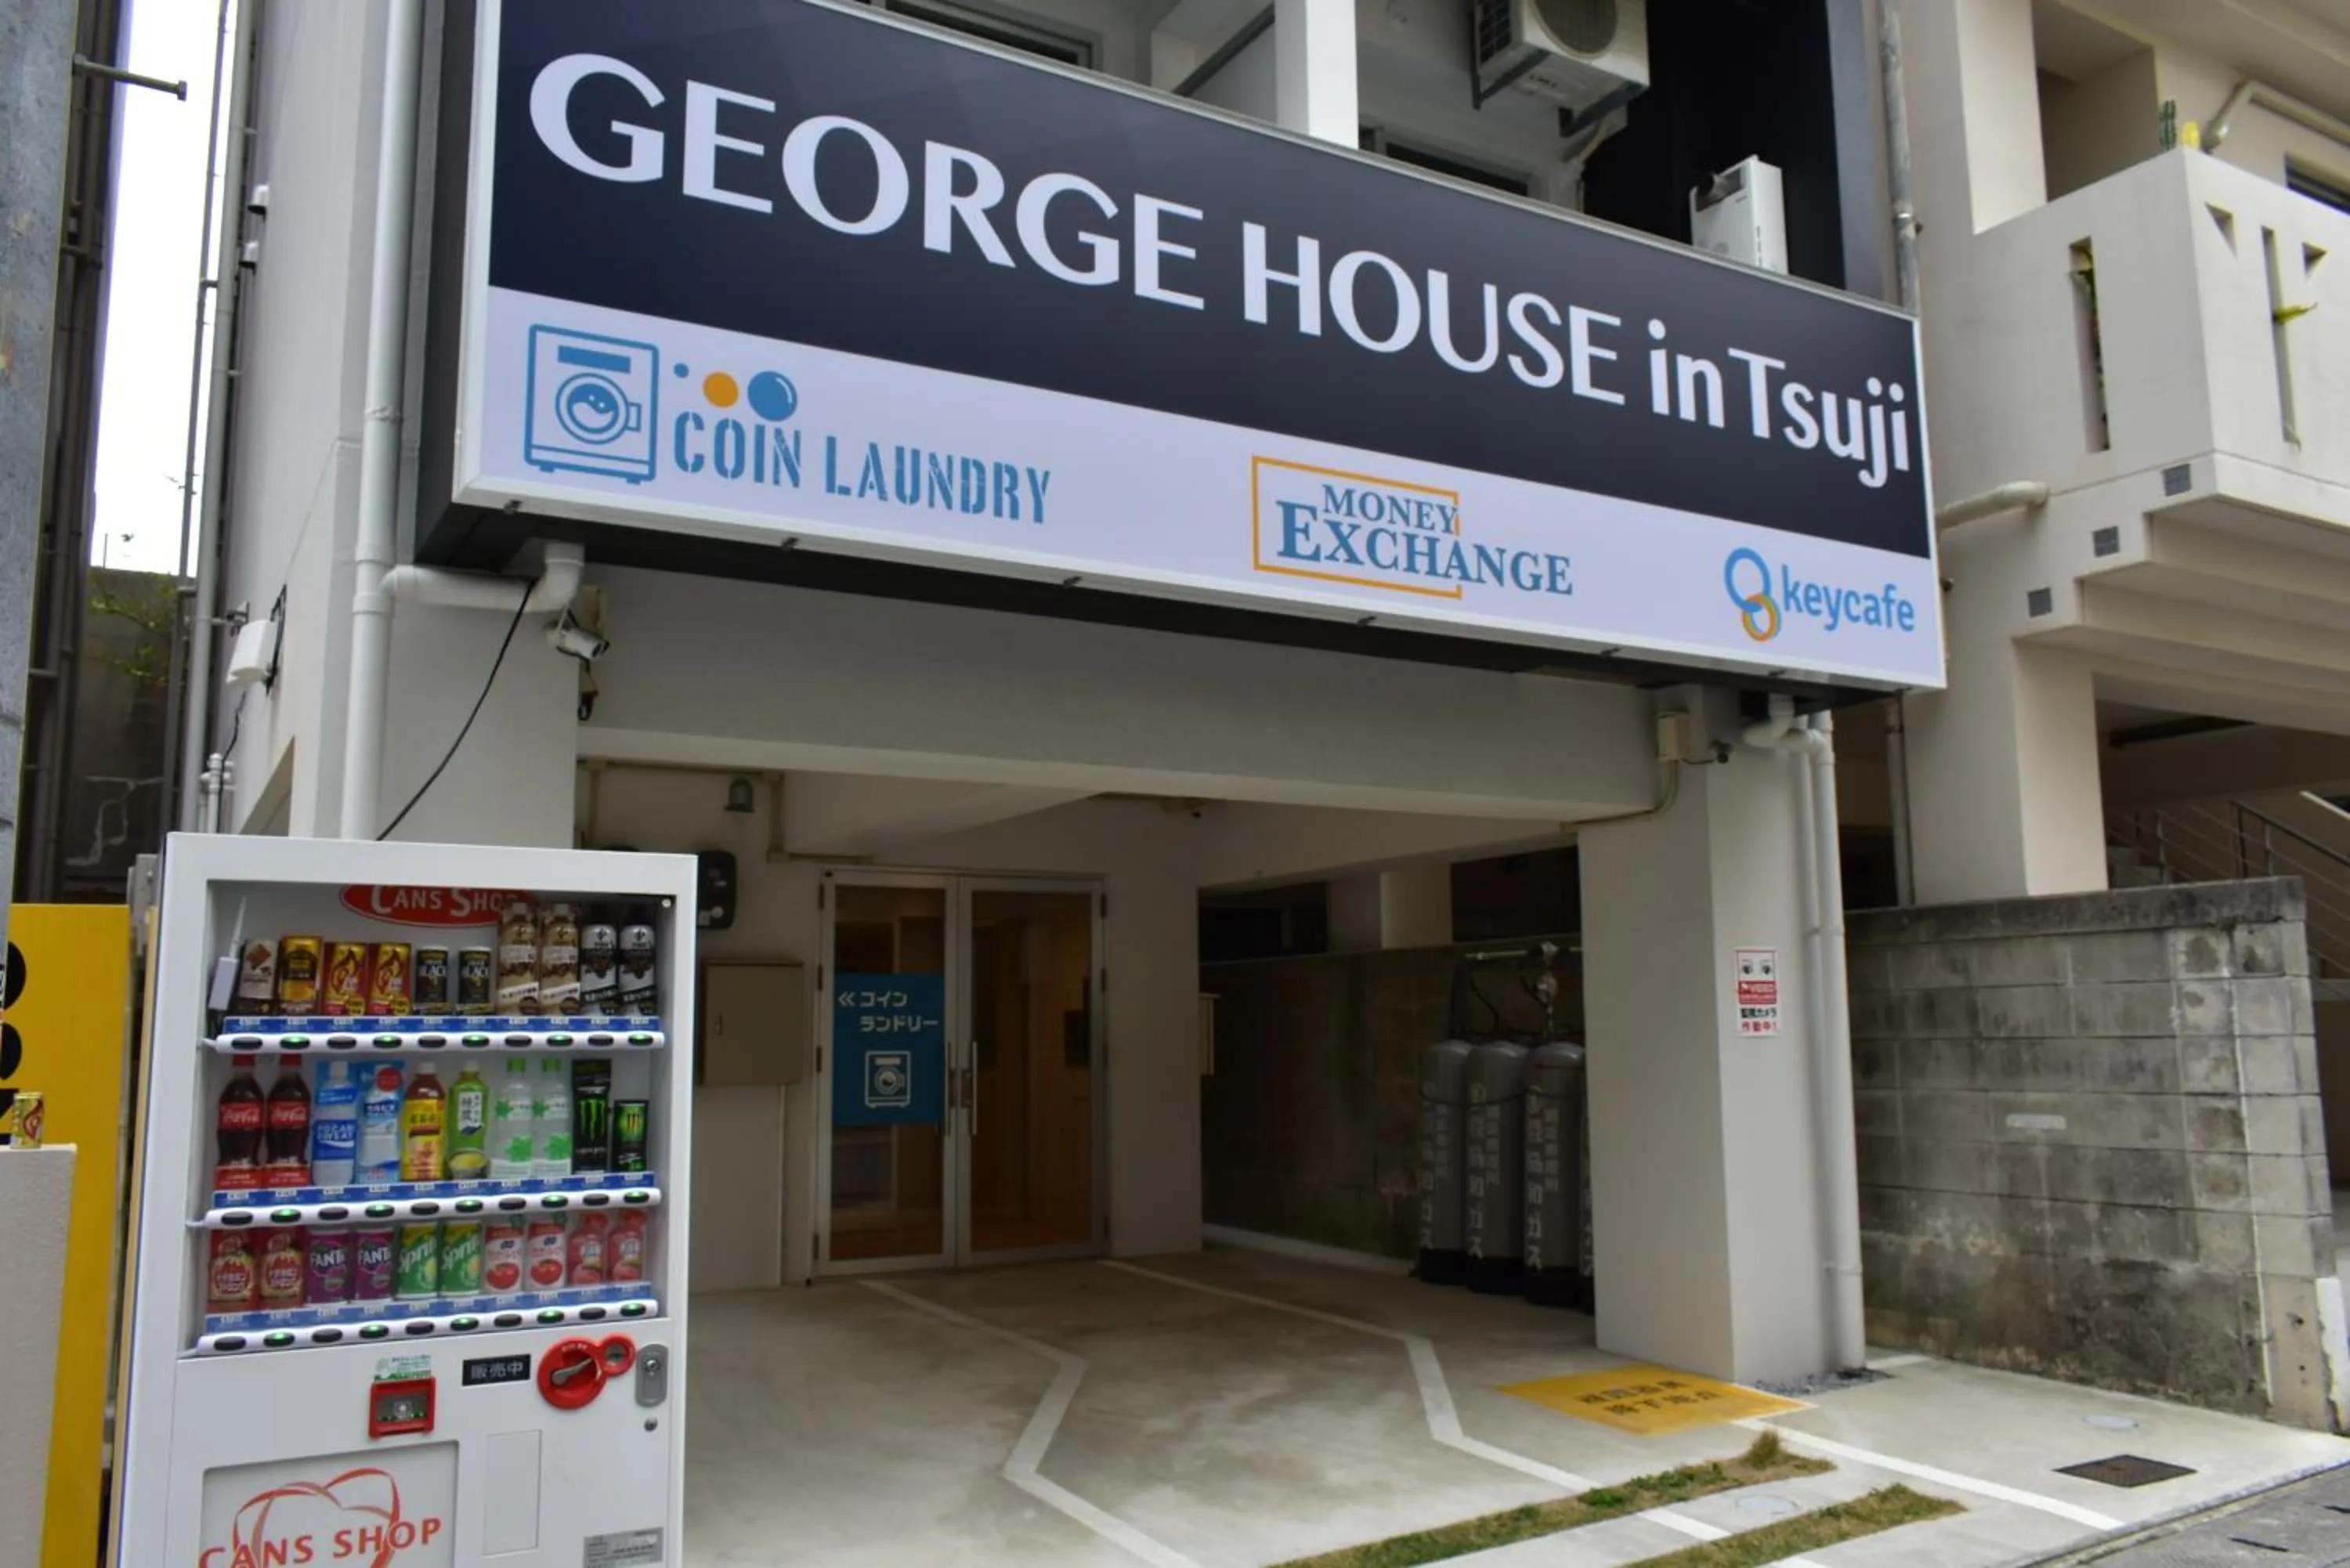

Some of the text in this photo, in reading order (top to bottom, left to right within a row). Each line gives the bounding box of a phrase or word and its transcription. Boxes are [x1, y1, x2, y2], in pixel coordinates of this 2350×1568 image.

[530, 52, 1204, 311] GEORGE
[1243, 221, 1625, 406] HOUSE
[674, 410, 1052, 524] COIN LAUNDRY
[1321, 483, 1459, 537] MONEY
[1276, 500, 1573, 596] EXCHANGE
[1781, 565, 1915, 632] keycafe
[371, 885, 442, 914] CANS
[859, 991, 908, 1008] コイン
[859, 1016, 939, 1033] ランドリー
[471, 1361, 525, 1378] 販売中
[199, 1517, 442, 1568] CANS SHOP
